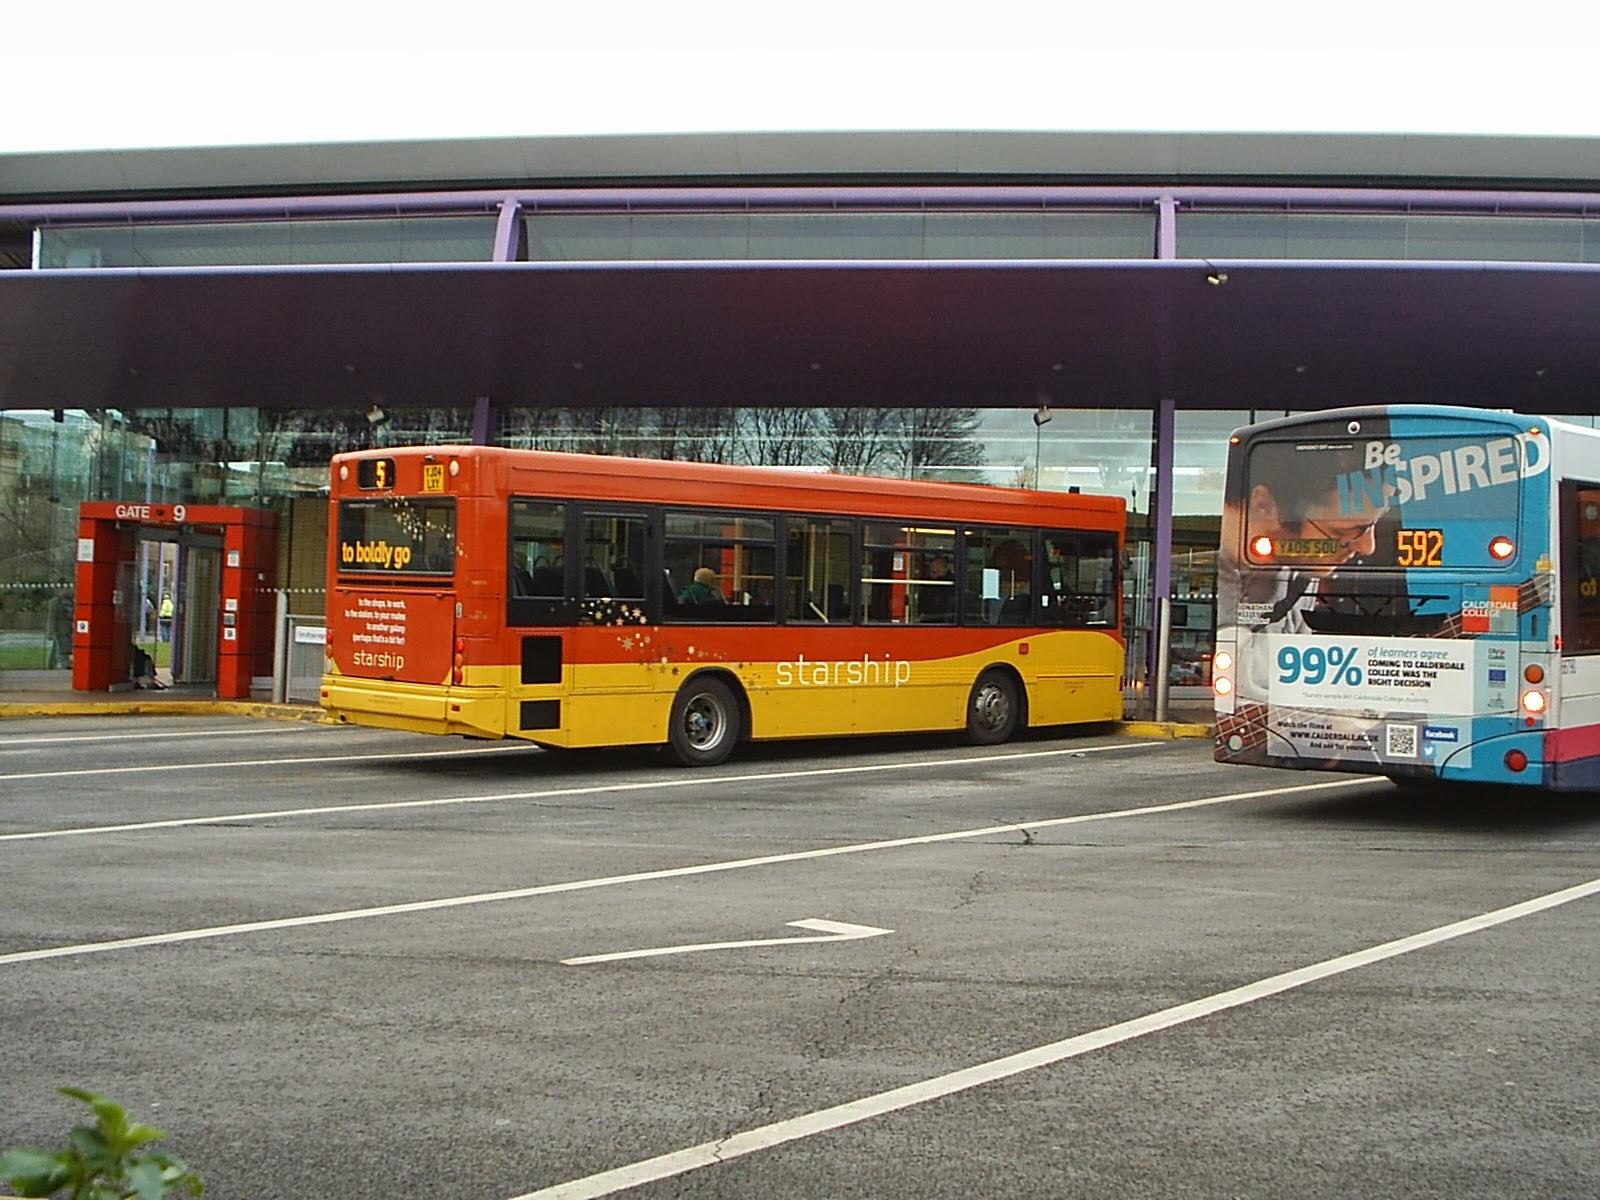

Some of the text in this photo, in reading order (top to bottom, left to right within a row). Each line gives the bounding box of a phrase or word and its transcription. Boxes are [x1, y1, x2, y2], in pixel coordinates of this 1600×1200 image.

[1365, 441, 1401, 469] Be
[376, 460, 386, 488] 5
[1336, 431, 1550, 515] INSPIRED
[115, 504, 186, 522] GATE 9
[342, 540, 411, 568] to boldly go
[1397, 530, 1444, 566] 592
[1462, 600, 1518, 610] CALDERDALE
[1462, 608, 1502, 618] COLLEGE
[353, 650, 404, 671] starship
[1368, 647, 1448, 660] of learners agree
[776, 653, 910, 688] starship
[1277, 646, 1362, 686] 99%
[1368, 660, 1465, 670] COMING TO CALDERDALE
[1402, 670, 1420, 678] WAS
[1368, 678, 1432, 688] RIGHT DECISION
[1426, 730, 1455, 738] facebook
